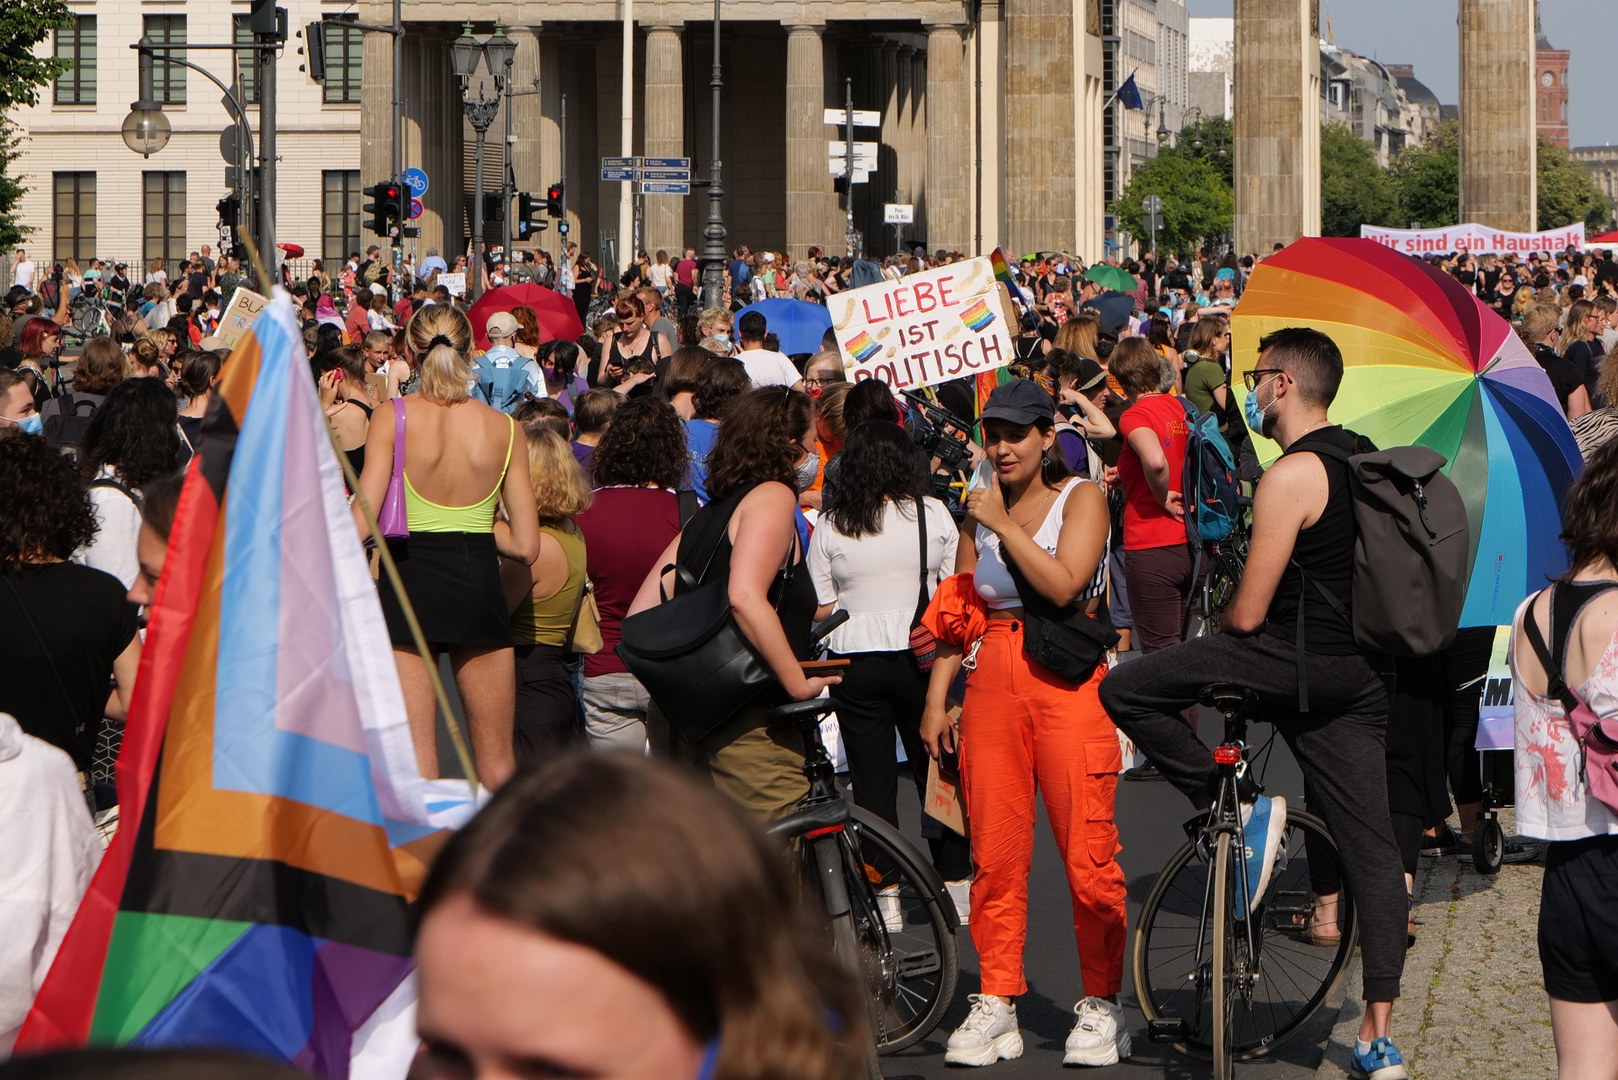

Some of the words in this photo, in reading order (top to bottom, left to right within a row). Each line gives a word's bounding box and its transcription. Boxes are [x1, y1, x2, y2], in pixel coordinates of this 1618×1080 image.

[1405, 233, 1448, 252] sind
[1454, 233, 1486, 250] ein
[1491, 232, 1581, 251] Haushalt
[862, 275, 960, 324] LIEBE
[898, 320, 939, 349] IST
[854, 334, 1003, 389] POLITISCH
